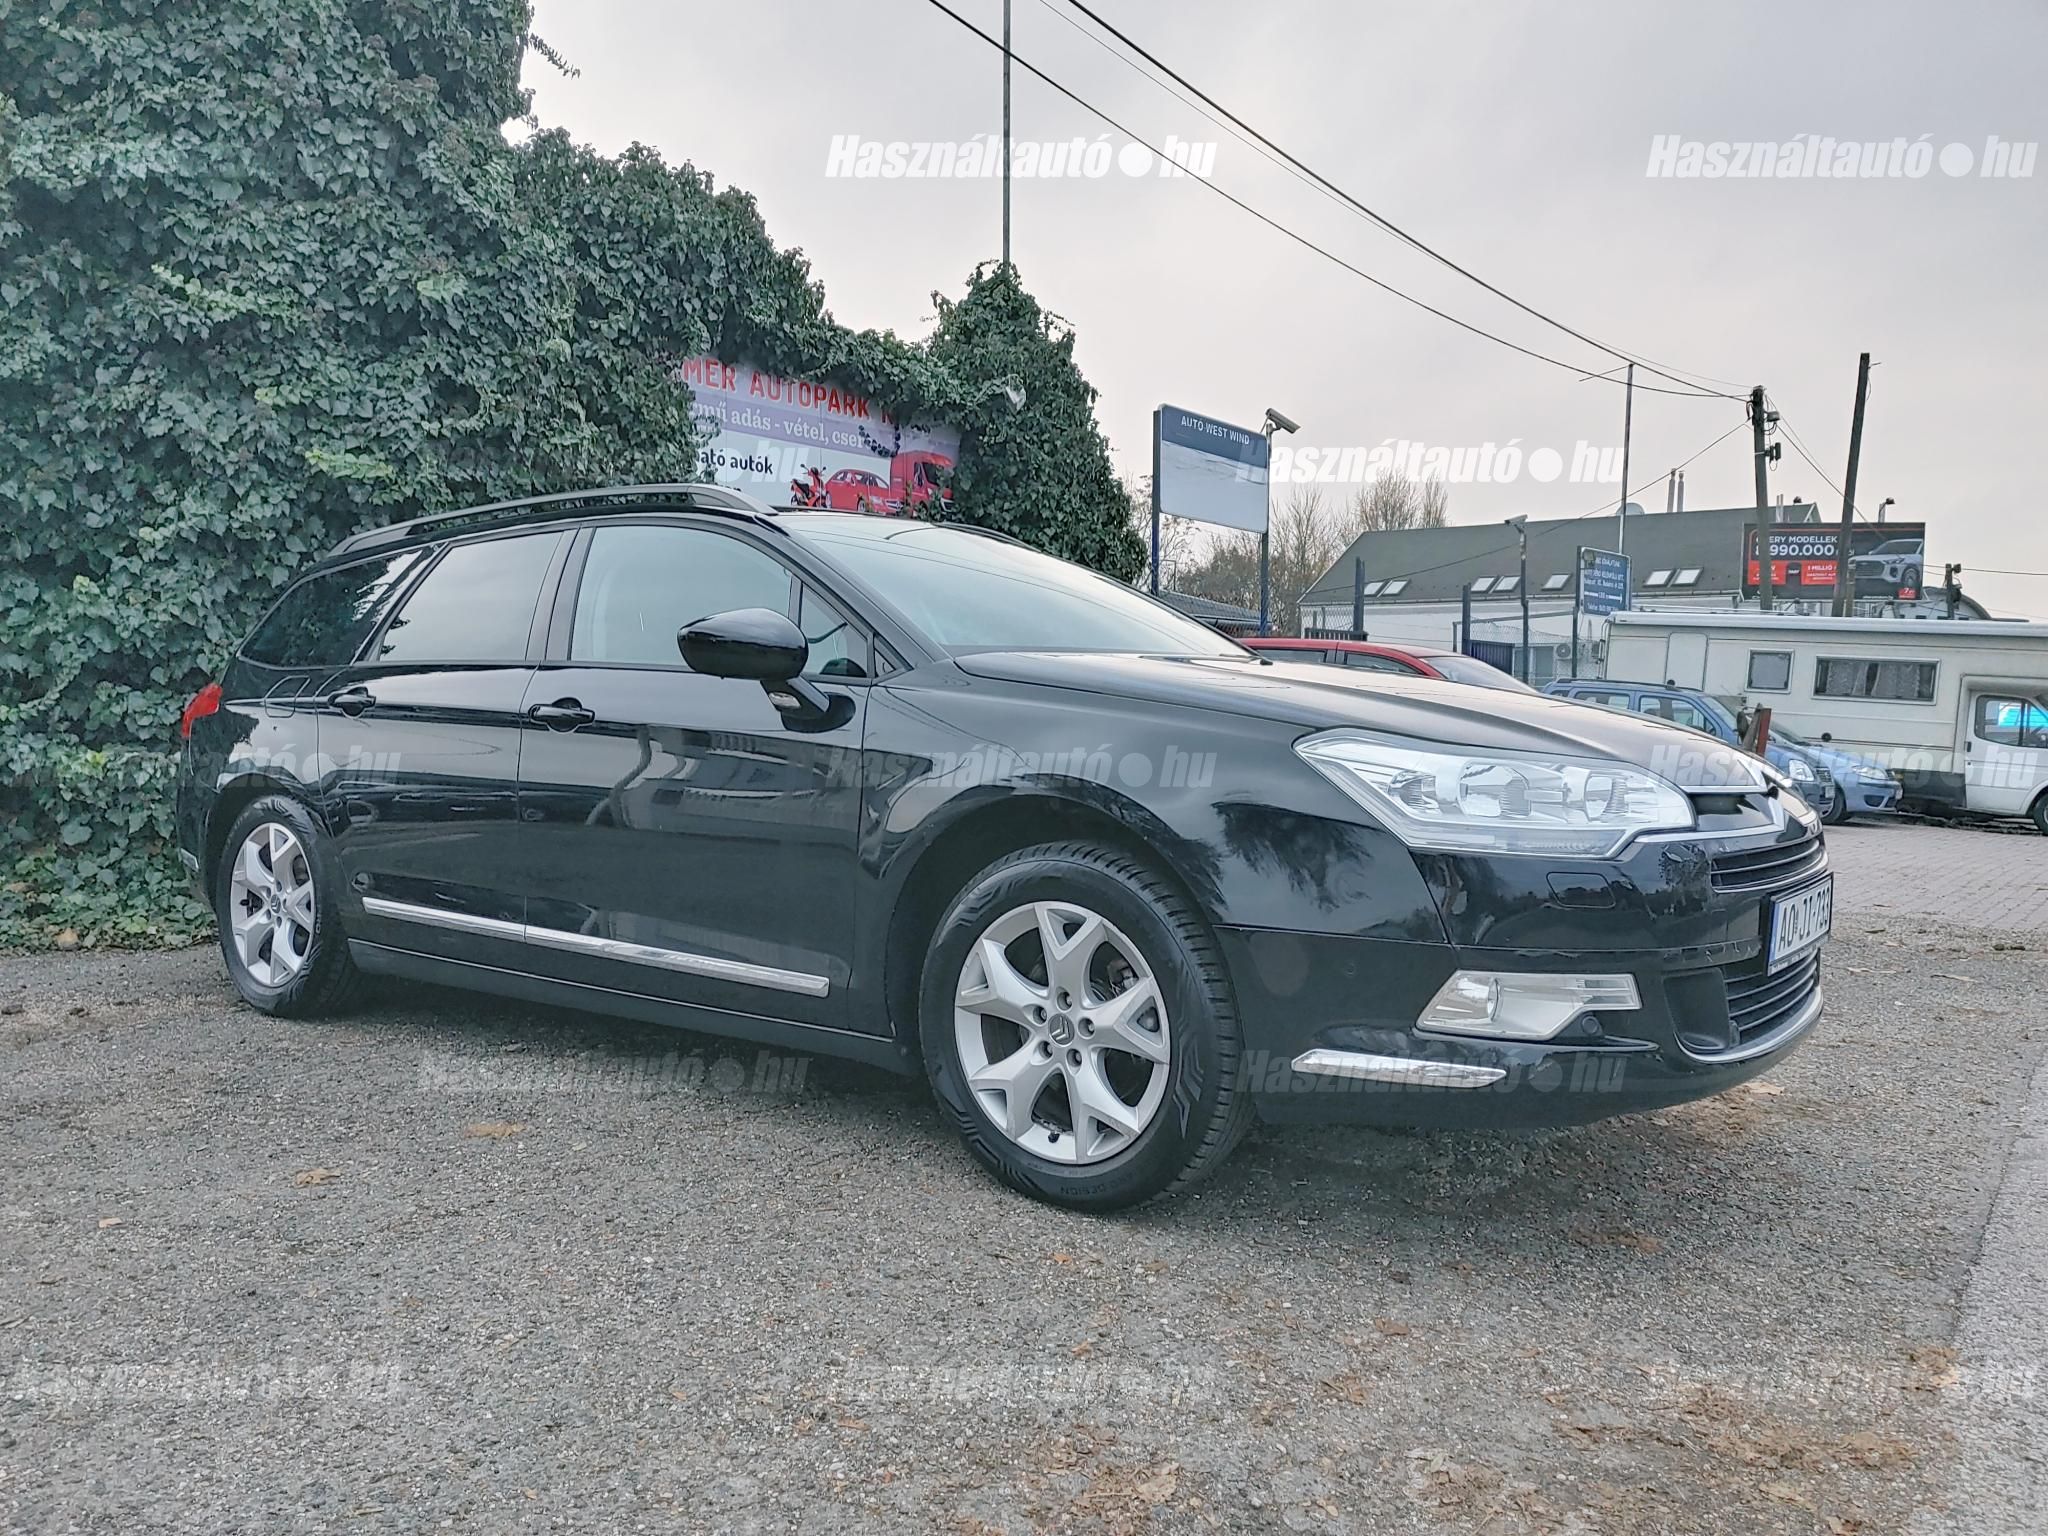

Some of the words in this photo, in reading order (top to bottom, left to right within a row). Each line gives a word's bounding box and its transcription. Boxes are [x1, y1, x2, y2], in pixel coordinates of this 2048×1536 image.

[750, 369, 869, 418] AUTOPARK
[731, 409, 771, 431] adás
[784, 415, 829, 445] vétel,
[1181, 415, 1204, 431] AUTO
[1206, 423, 1228, 439] WEST
[1229, 430, 1250, 445] WIND
[696, 448, 726, 467] ató
[730, 455, 773, 475] autók
[1756, 544, 1835, 556] 990.000
[1788, 535, 1838, 544] MODELLEK
